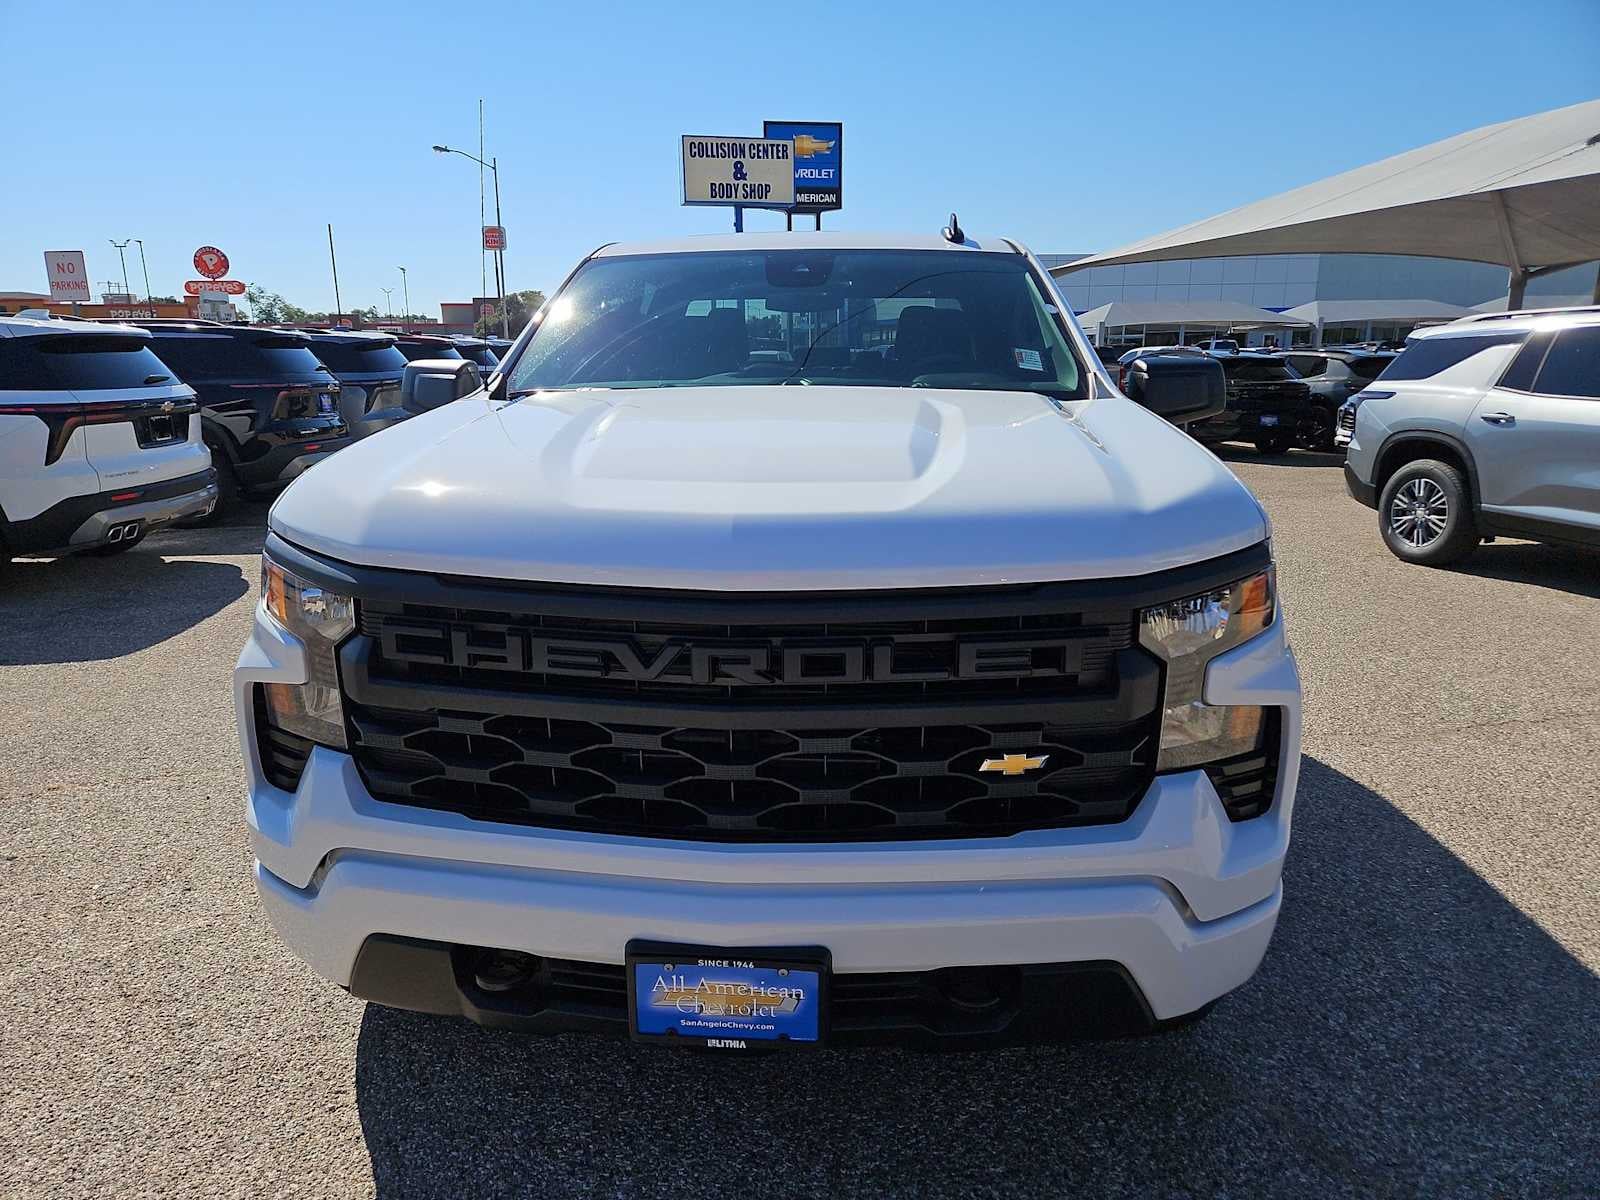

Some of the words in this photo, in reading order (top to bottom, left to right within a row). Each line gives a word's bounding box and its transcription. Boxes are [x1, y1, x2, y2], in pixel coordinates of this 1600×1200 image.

[689, 141, 746, 159] COLLISION
[749, 143, 789, 160] CENTER
[733, 160, 747, 181] &
[710, 183, 740, 199] BODY
[742, 184, 771, 200] SHOP
[56, 262, 75, 274] NO
[201, 254, 218, 270] P
[51, 280, 88, 290] PARKING
[379, 623, 1085, 686] CHEVROLET
[697, 959, 729, 968] SINCE
[733, 960, 755, 969] 1946
[651, 975, 686, 993] All
[695, 977, 805, 999] American
[675, 995, 777, 1018] Chevrolet
[680, 1019, 775, 1031] SanAngeloChevy.com
